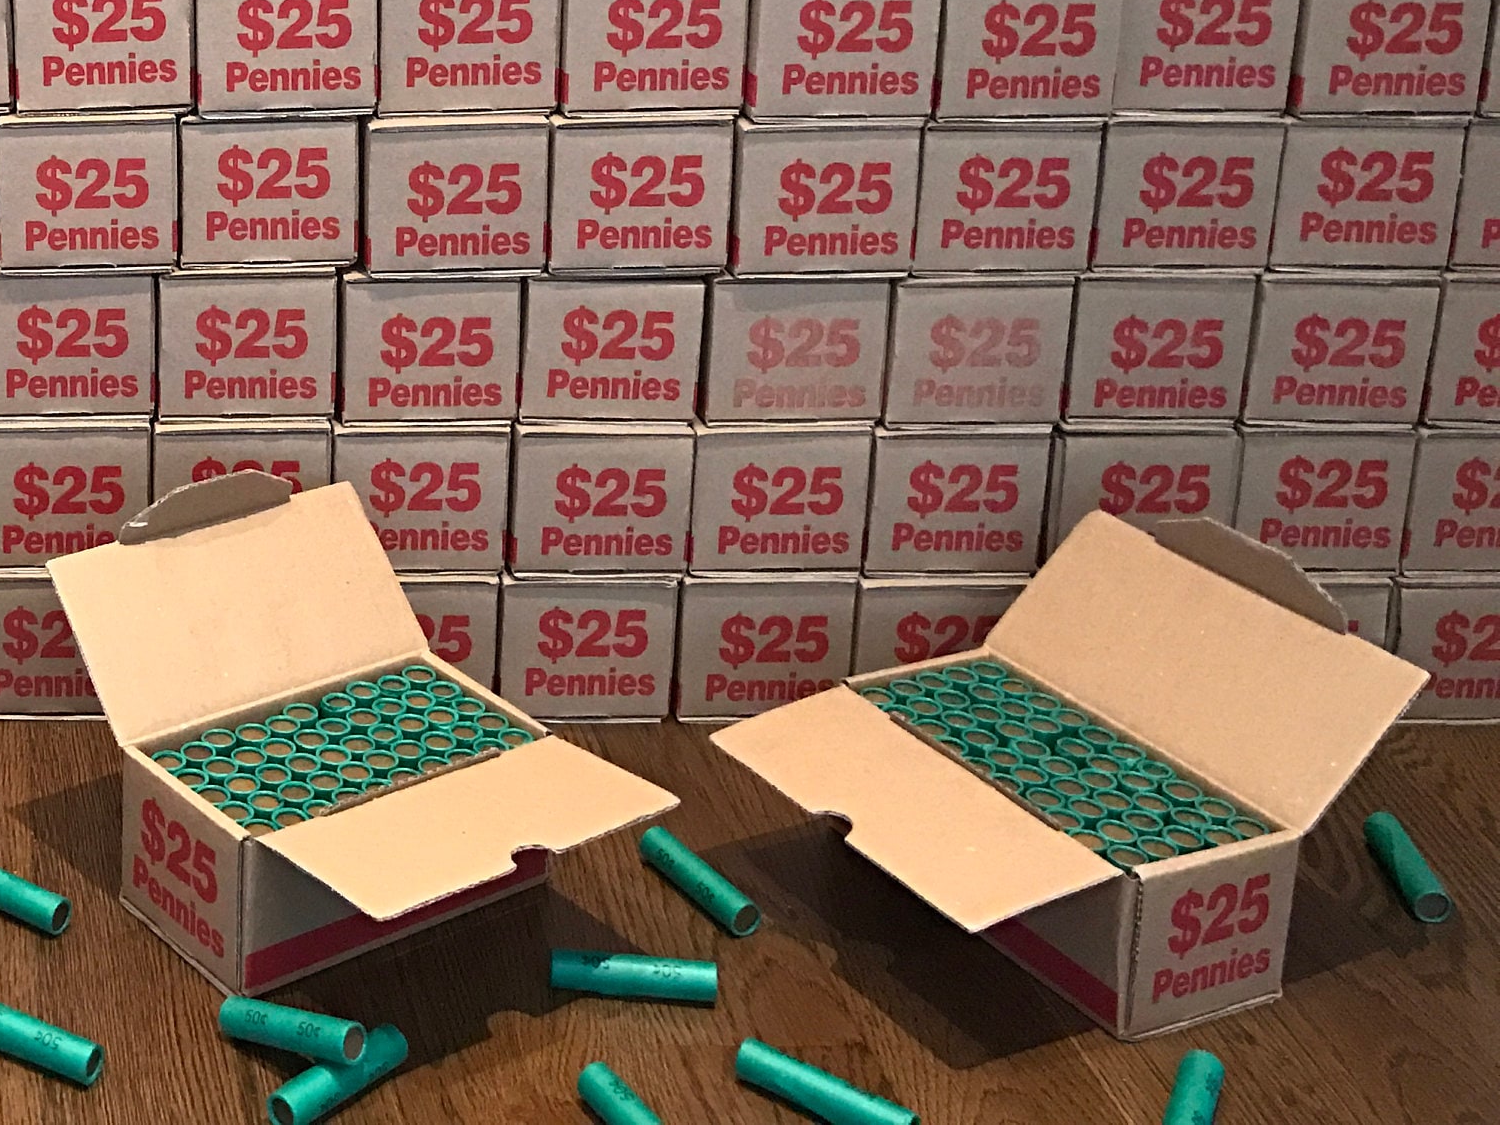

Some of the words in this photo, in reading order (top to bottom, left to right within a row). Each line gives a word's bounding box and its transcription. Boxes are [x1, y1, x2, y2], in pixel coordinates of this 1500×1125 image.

[982, 0, 1097, 62] $25
[1348, 0, 1463, 61] $25
[966, 68, 1100, 99] Pennies
[1329, 64, 1465, 96] Pennies
[36, 156, 149, 217] $25
[407, 161, 522, 222] $25
[956, 154, 1071, 216] $25
[1317, 148, 1434, 208] $25
[24, 218, 159, 251] Pennies
[395, 226, 530, 257] Pennies
[940, 218, 1074, 250] Pennies
[1300, 211, 1437, 245] Pennies
[196, 305, 308, 367] $25
[561, 306, 675, 366] $25
[746, 314, 861, 373] $25
[1111, 316, 1224, 373] $25
[184, 369, 318, 399] Pennies
[547, 369, 680, 401] Pennies
[733, 377, 866, 408] Pennies
[1094, 378, 1227, 409] Pennies
[731, 464, 843, 521] $25
[1276, 456, 1388, 514] $25
[2, 523, 112, 555] Pennie
[718, 525, 849, 555] Pennies
[1259, 518, 1391, 552] Pennies
[537, 607, 648, 664] $25
[1431, 610, 1500, 669] $2
[524, 667, 655, 696] Pennies
[140, 797, 218, 906] $25
[132, 856, 225, 958] Pennies
[1167, 873, 1271, 956] $25
[1151, 948, 1271, 1005] Pennies
